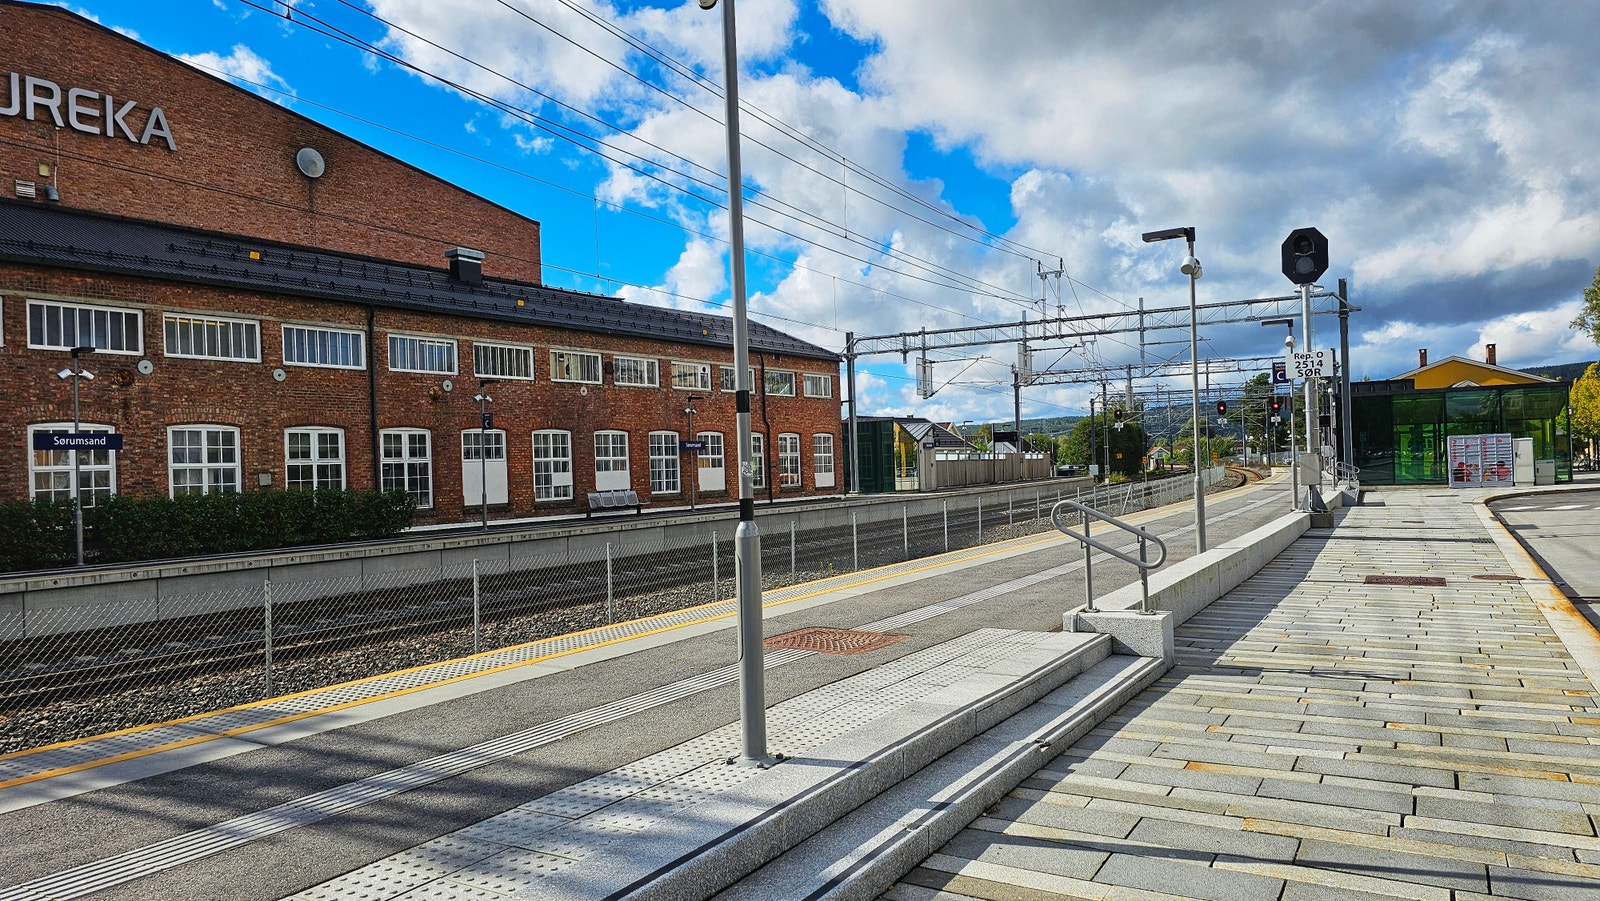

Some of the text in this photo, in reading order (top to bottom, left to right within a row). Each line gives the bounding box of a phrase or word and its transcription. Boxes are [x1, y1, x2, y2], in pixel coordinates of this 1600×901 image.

[1294, 352, 1314, 361] Rep.
[1294, 360, 1324, 370] 2514
[1276, 370, 1285, 381] C
[1297, 368, 1322, 378] SØR
[53, 436, 106, 446] Sørumsand
